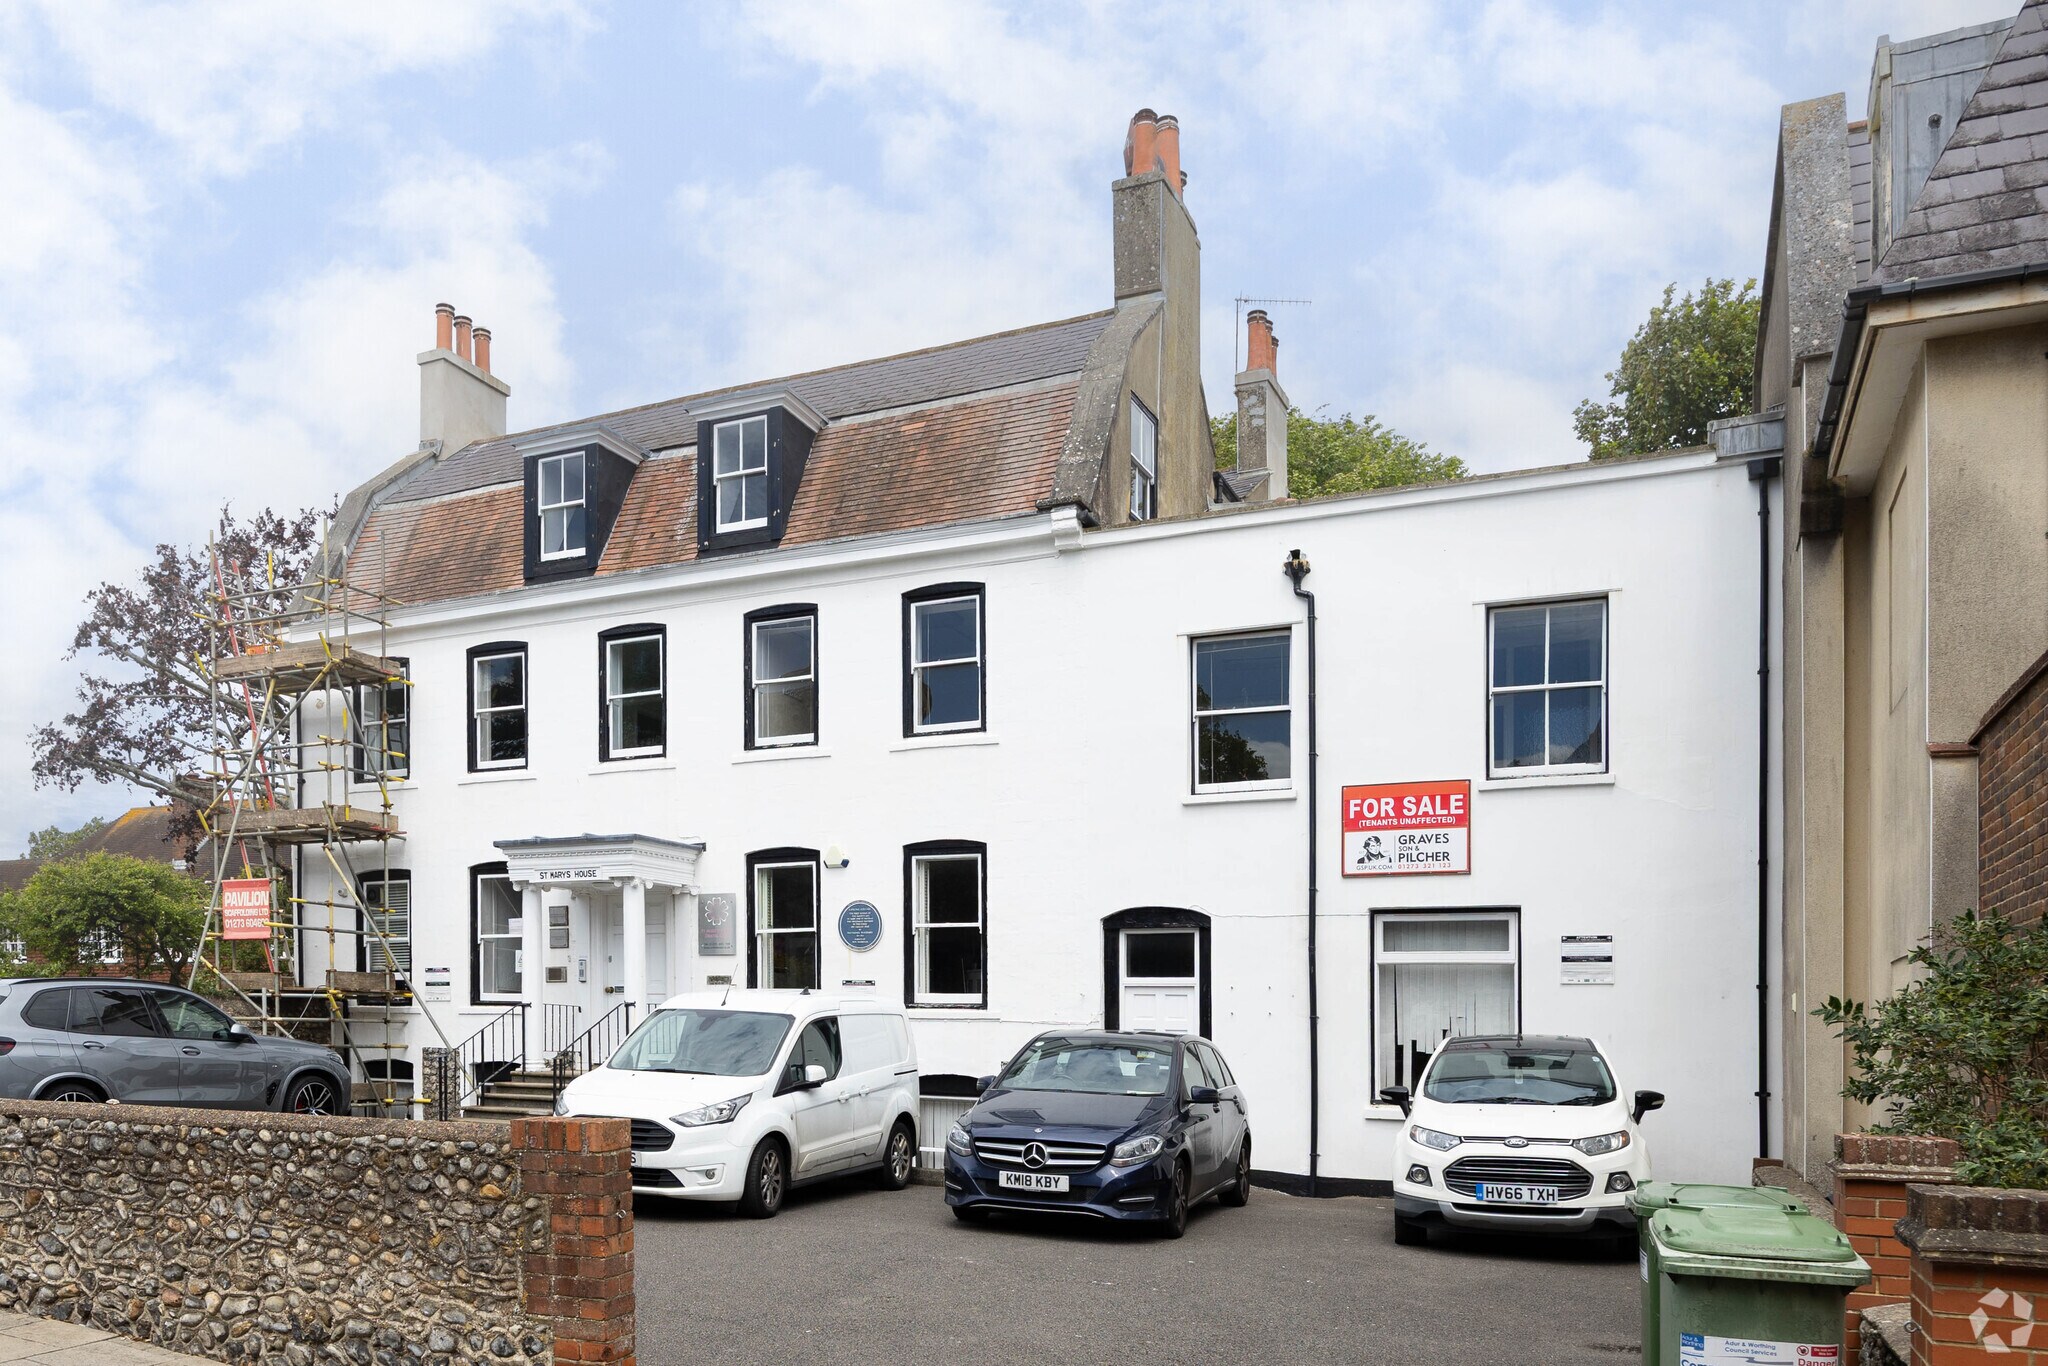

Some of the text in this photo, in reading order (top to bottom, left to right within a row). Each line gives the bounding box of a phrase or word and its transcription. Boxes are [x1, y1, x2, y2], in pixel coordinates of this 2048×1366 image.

[1349, 794, 1464, 819] FOR SALE
[1358, 816, 1456, 828] (TENANTS UNAFFECTED)
[1398, 833, 1450, 845] GRAVES
[1398, 851, 1451, 863] PILCHER
[540, 871, 548, 880] ST
[574, 869, 597, 878] HOUSE
[224, 890, 270, 907] PAVILION
[224, 907, 269, 917] SCAFFOLDING LTD
[225, 919, 245, 929] 01273
[1006, 1173, 1061, 1189] KM18 KBY
[1485, 1186, 1555, 1202] HV66 TXH
[1748, 1342, 1776, 1351] Worthing
[1750, 1349, 1777, 1357] Services
